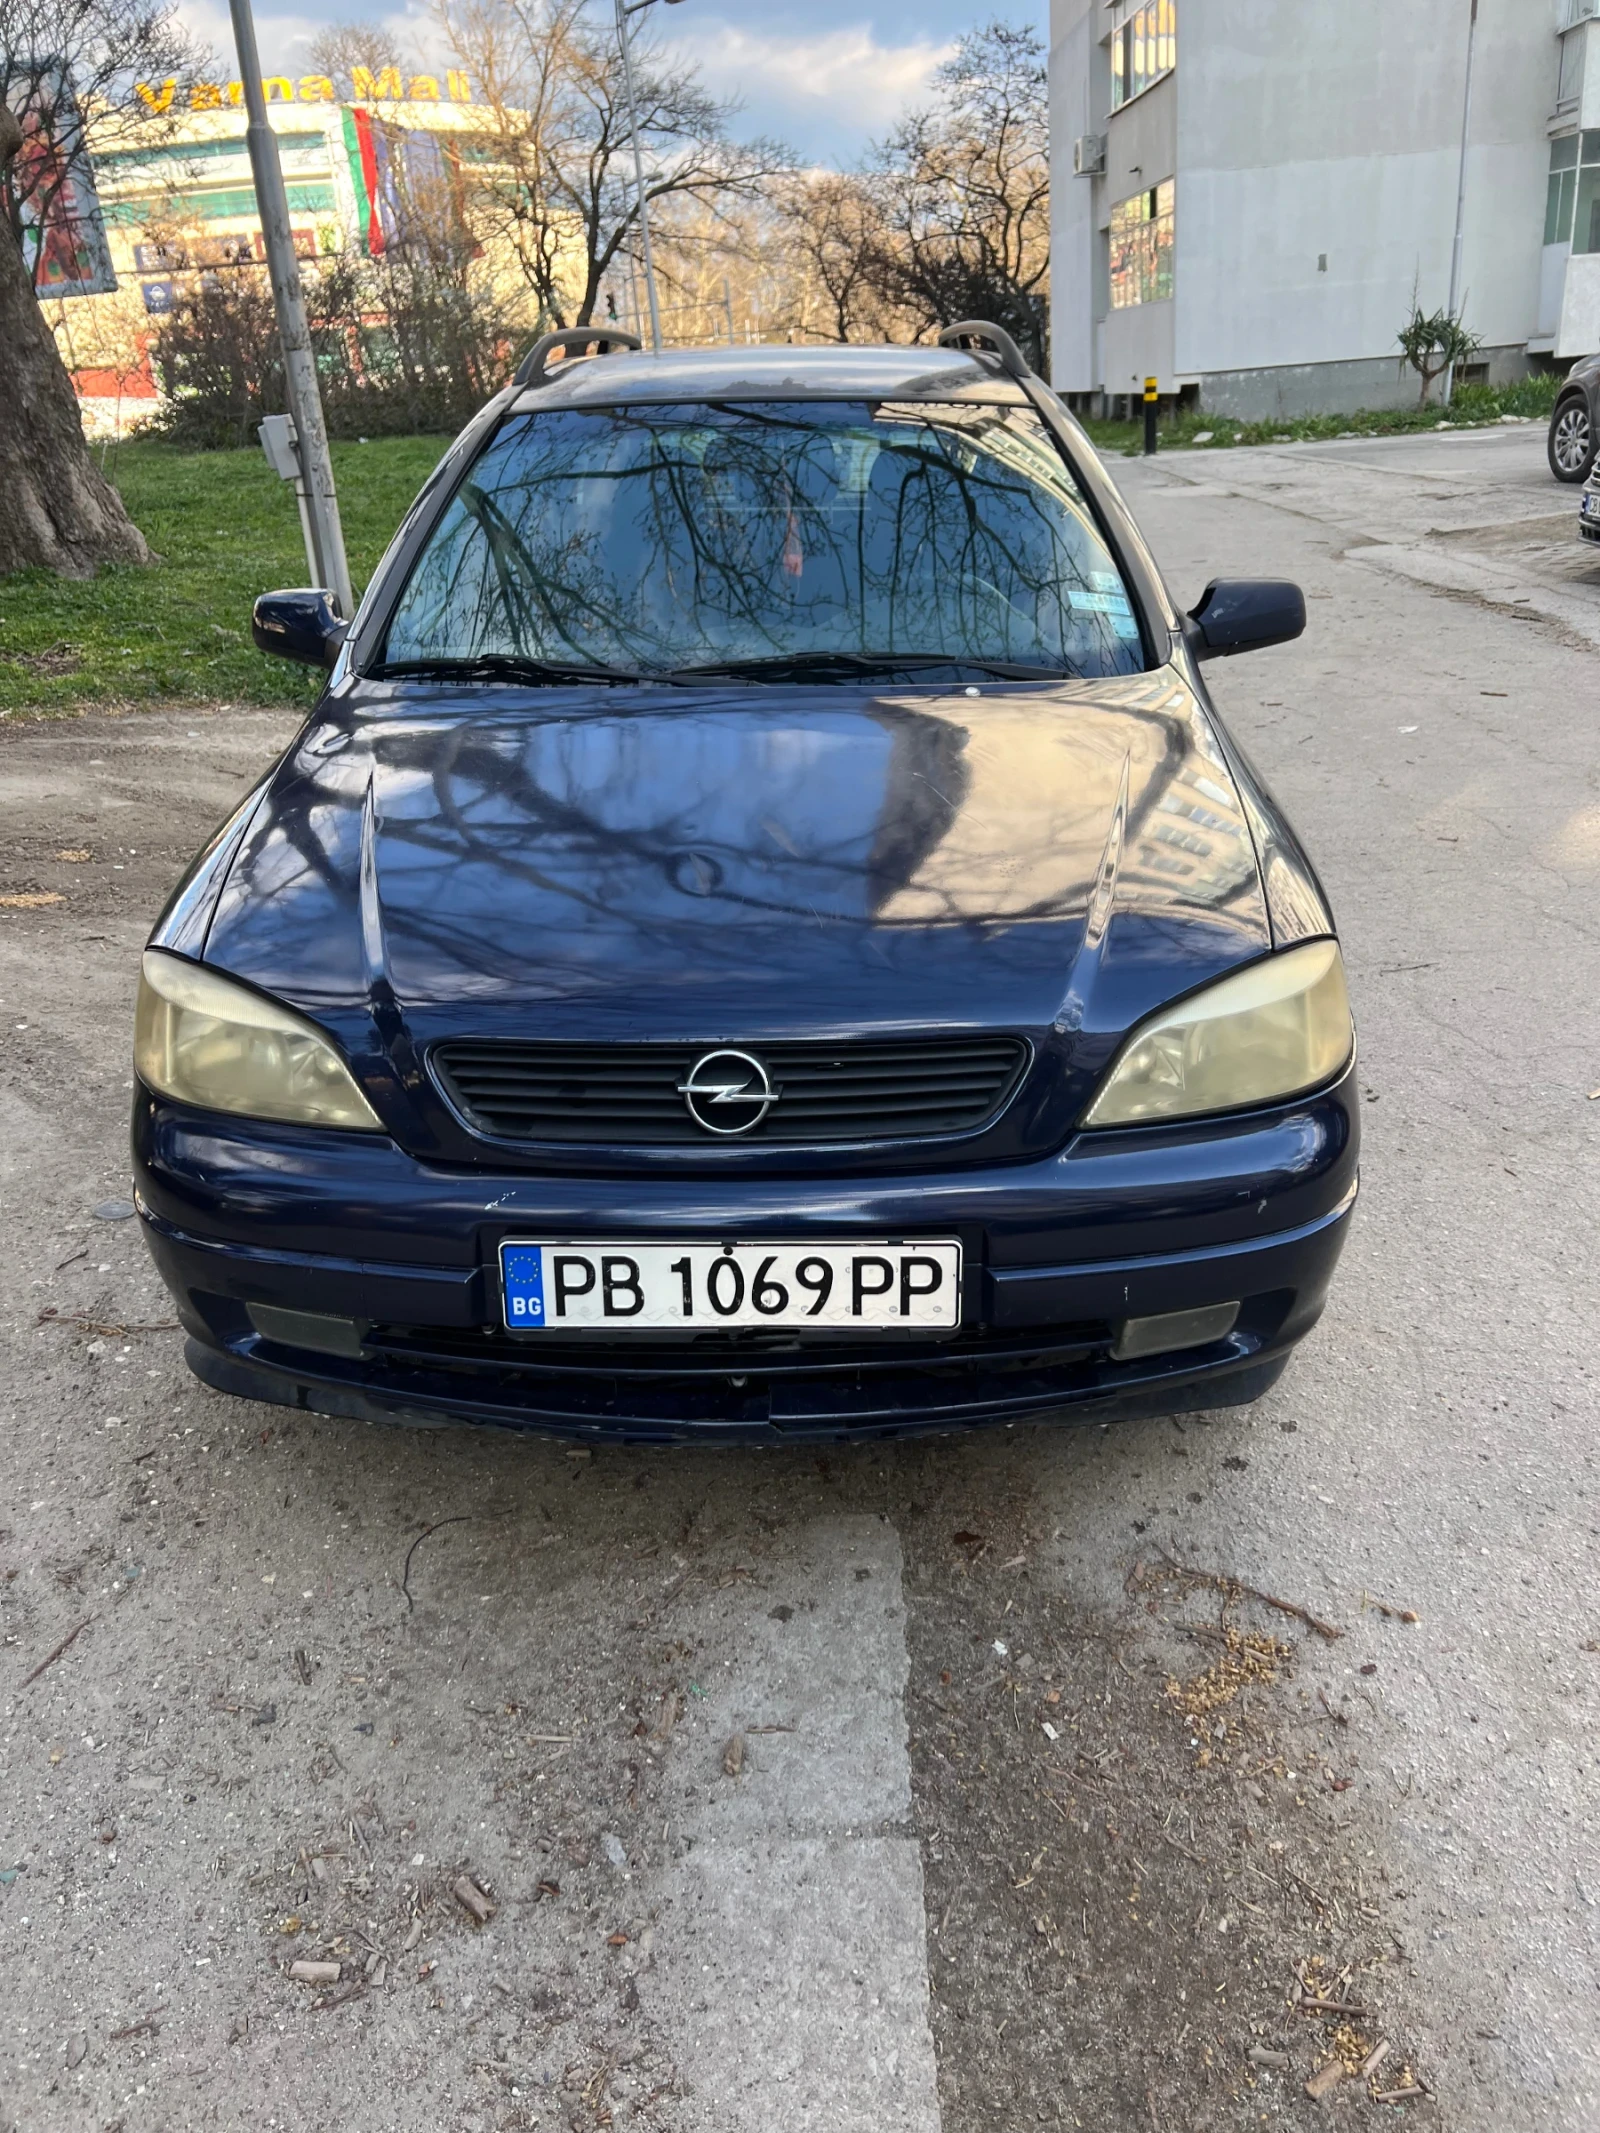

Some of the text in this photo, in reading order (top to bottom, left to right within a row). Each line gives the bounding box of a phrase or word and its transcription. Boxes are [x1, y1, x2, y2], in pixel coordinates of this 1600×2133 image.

[351, 66, 472, 102] Mall
[553, 1255, 943, 1317] PB 1069 PP
[512, 1297, 542, 1316] BG
